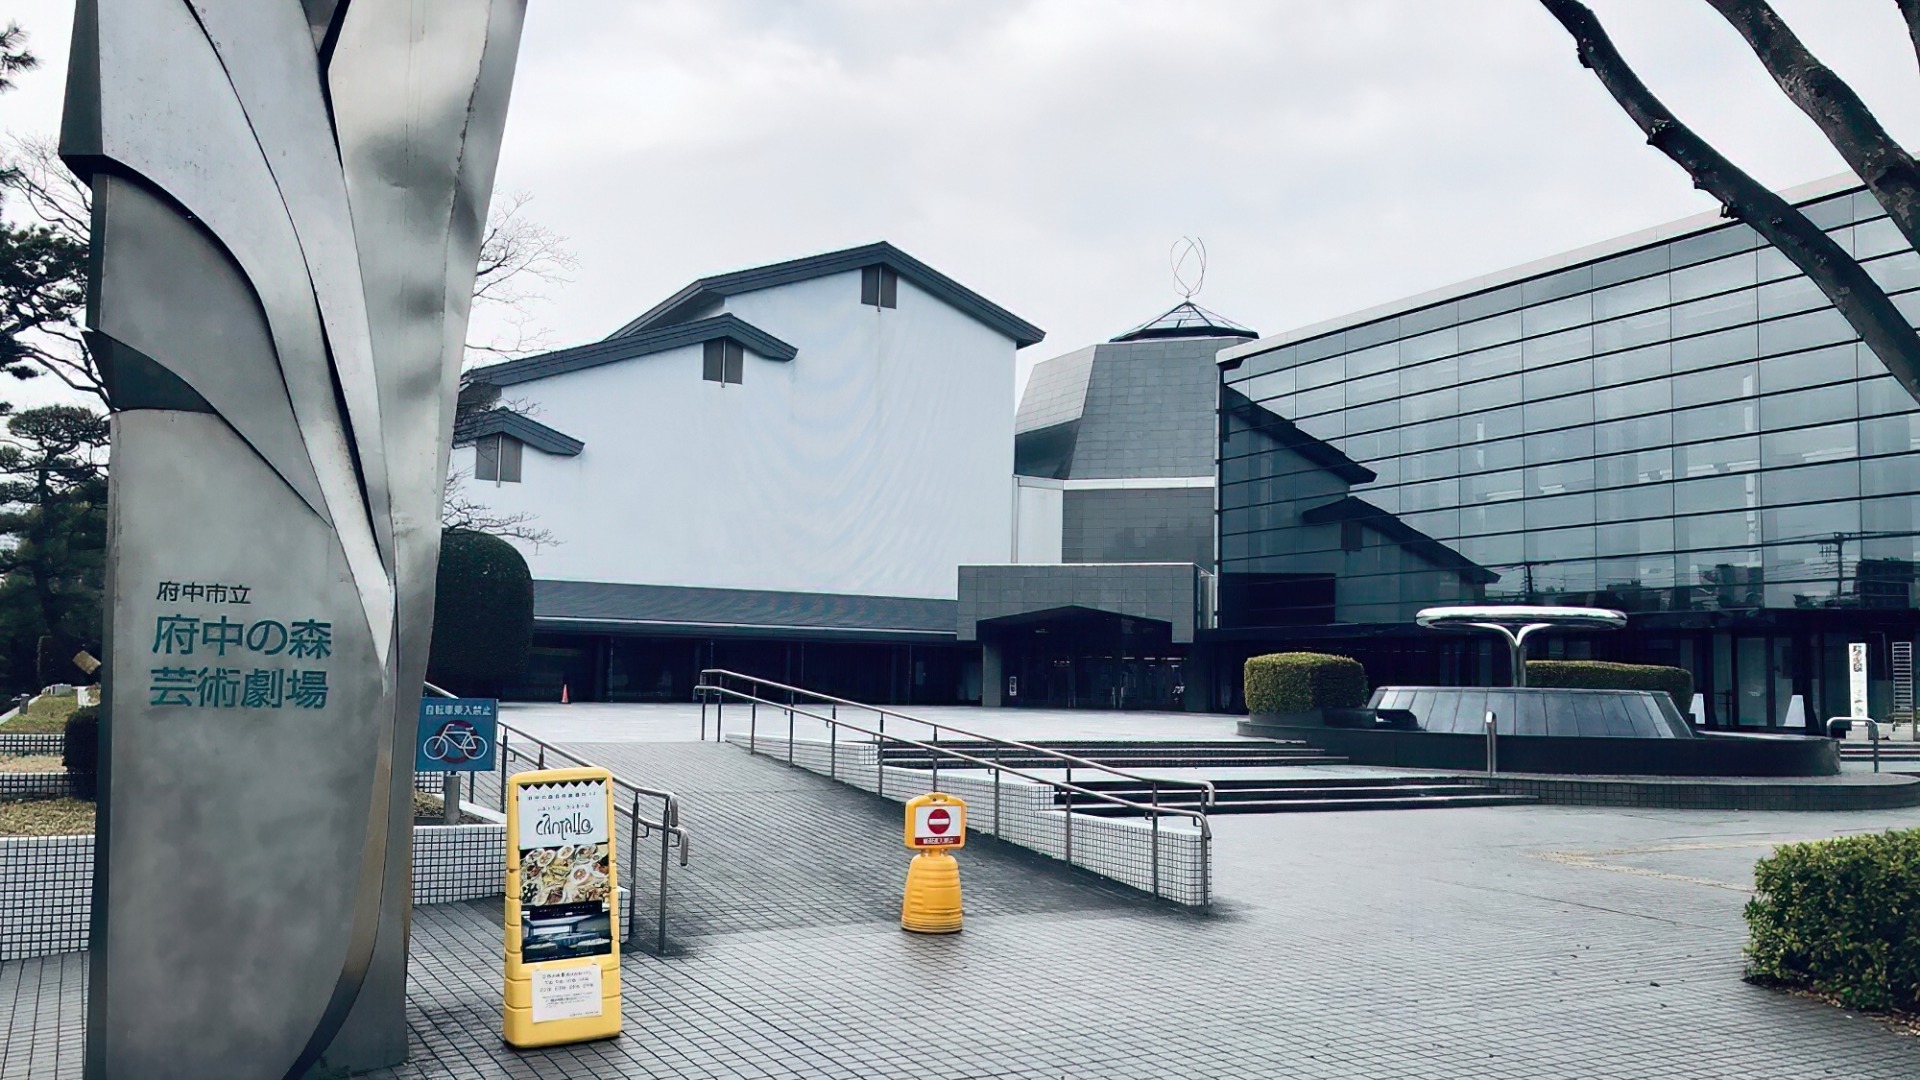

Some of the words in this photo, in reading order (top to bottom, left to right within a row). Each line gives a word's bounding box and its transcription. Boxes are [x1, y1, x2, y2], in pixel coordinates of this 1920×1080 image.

[157, 581, 251, 604] 府中市立
[152, 614, 332, 659] 府中の森
[150, 667, 328, 709] 芸術劇場
